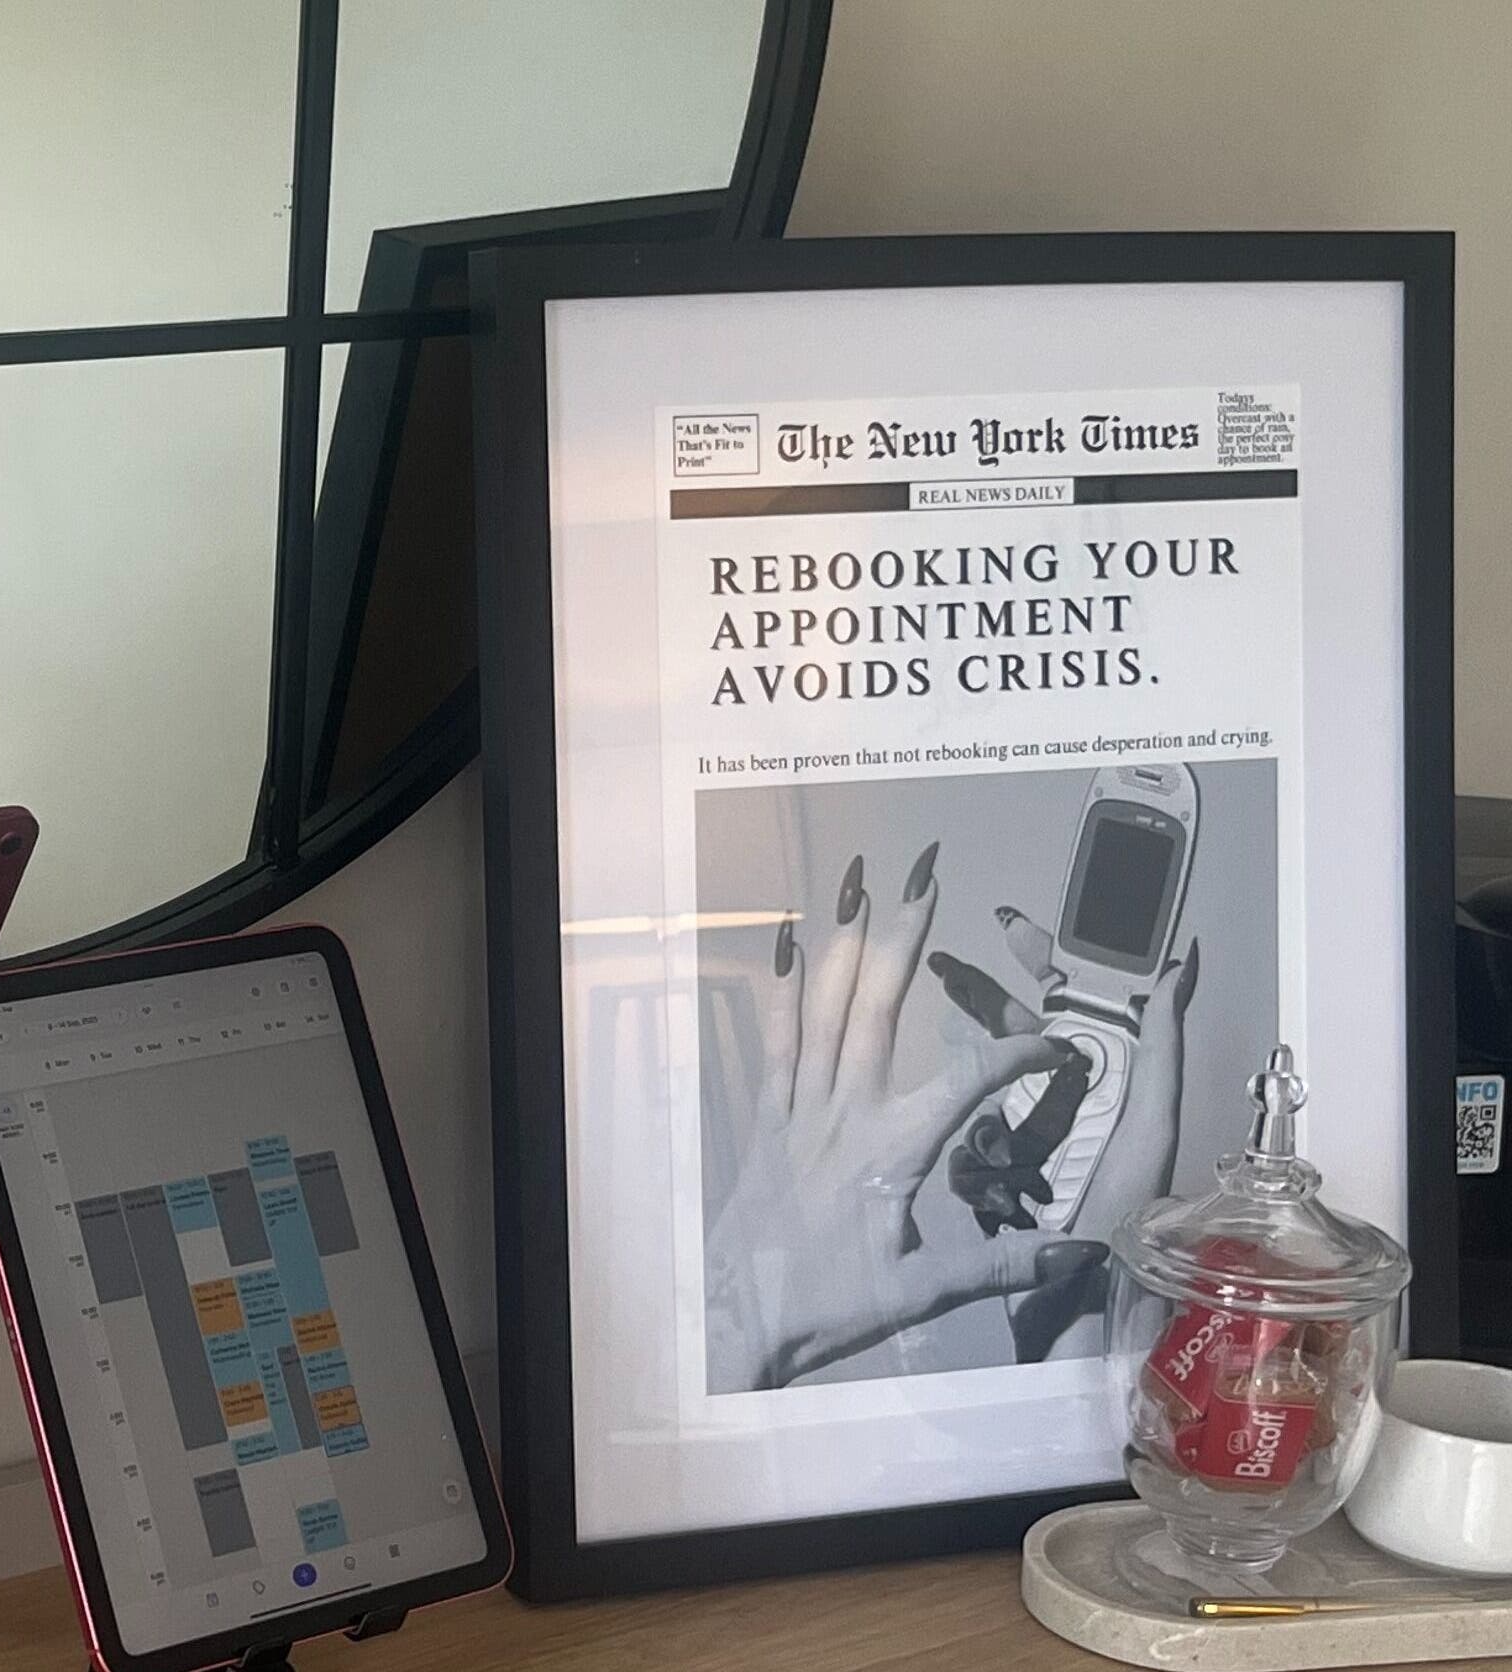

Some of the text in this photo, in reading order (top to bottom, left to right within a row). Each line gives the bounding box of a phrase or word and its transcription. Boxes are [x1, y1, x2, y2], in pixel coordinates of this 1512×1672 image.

[703, 423, 720, 434] the
[722, 422, 752, 434] News
[777, 415, 1199, 469] The New York Times
[1264, 411, 1286, 422] with
[1288, 413, 1295, 422] a
[677, 439, 745, 451] That's Fit to
[918, 485, 1066, 505] REAL NEWS DAILY
[710, 538, 1239, 596] REBOOKING YOUR
[710, 595, 1132, 651] APPOINTMENT
[711, 648, 1159, 706] AVOIDS CRISIS.
[698, 727, 1273, 775] It has been proven that not rebooking can cause desperation and crying.
[1170, 1311, 1233, 1381] scoff
[1235, 1410, 1288, 1478] Biscoff
